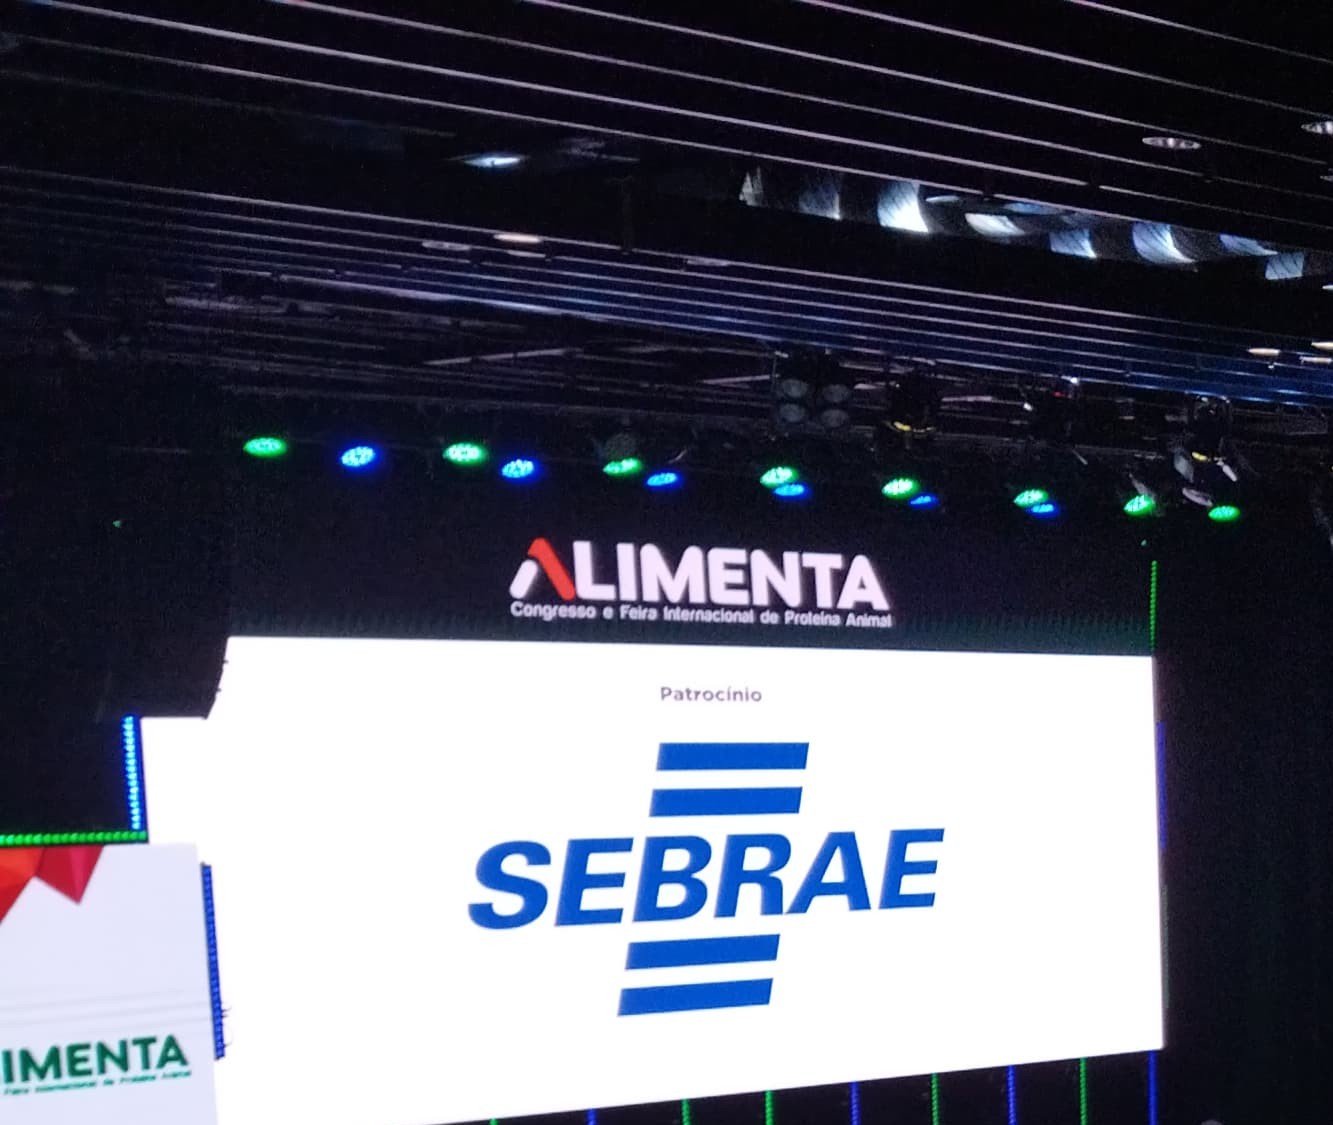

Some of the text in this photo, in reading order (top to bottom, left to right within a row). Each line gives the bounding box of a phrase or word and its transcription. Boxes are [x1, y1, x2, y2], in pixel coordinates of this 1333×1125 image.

[509, 537, 890, 611] ALIMENTA
[510, 601, 597, 621] Congresso
[602, 607, 614, 619] e
[619, 605, 658, 620] Feira
[663, 606, 754, 623] Internacional
[760, 610, 779, 624] de
[845, 613, 892, 628] Animal
[660, 686, 763, 702] Patrocínio
[468, 827, 945, 930] SEBRAE
